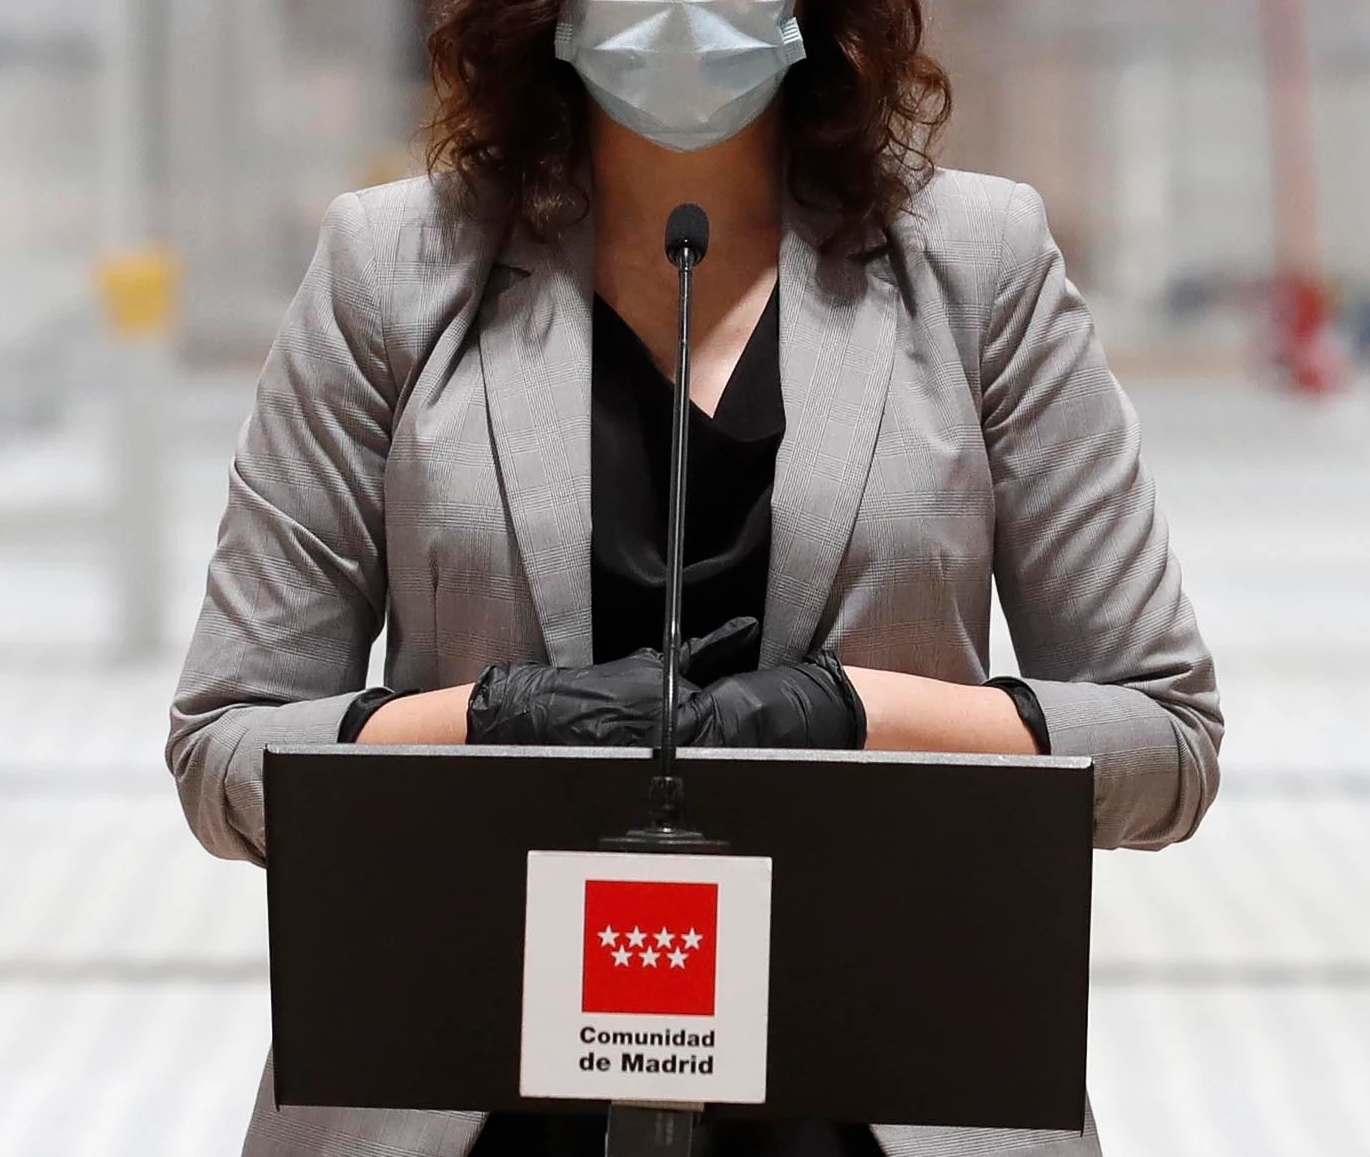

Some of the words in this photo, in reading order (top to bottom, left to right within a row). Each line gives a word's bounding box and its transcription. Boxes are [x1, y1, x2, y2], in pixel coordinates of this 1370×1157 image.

[579, 1026, 716, 1048] Comunidad
[579, 1052, 611, 1072] de
[621, 1053, 715, 1075] Madrid
